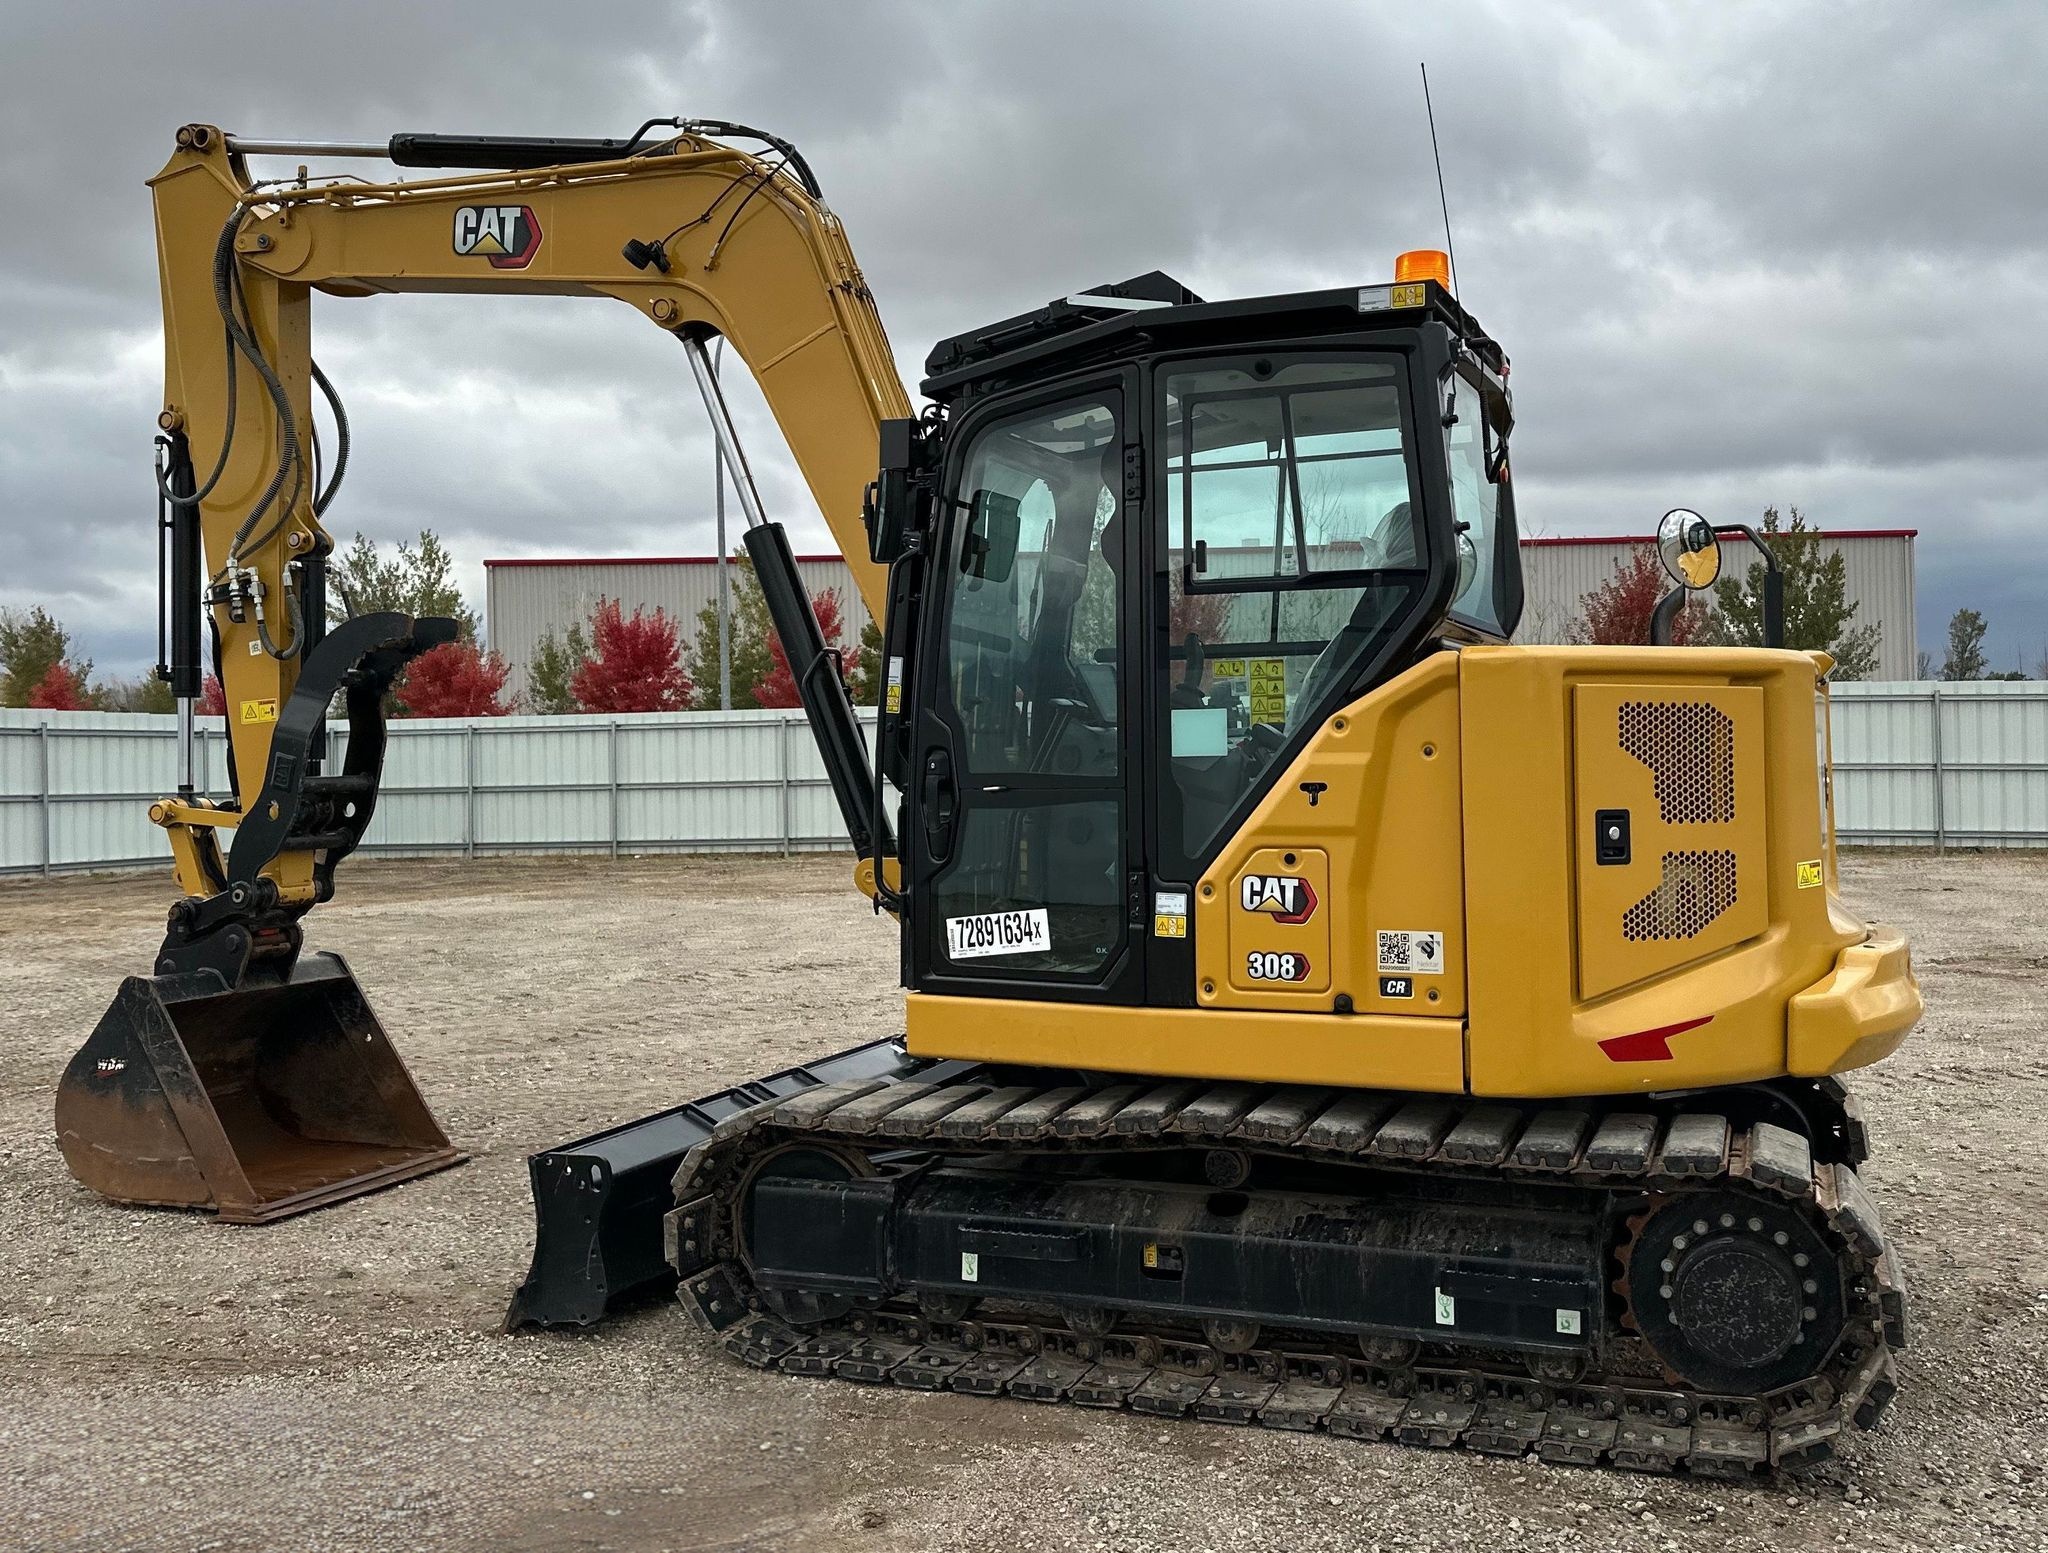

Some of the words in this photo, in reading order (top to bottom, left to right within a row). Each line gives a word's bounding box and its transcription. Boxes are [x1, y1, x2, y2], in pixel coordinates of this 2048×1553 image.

[455, 207, 521, 254] CAT
[1242, 875, 1299, 913] CAT
[1248, 952, 1295, 979] 308
[1386, 980, 1406, 994] CR
